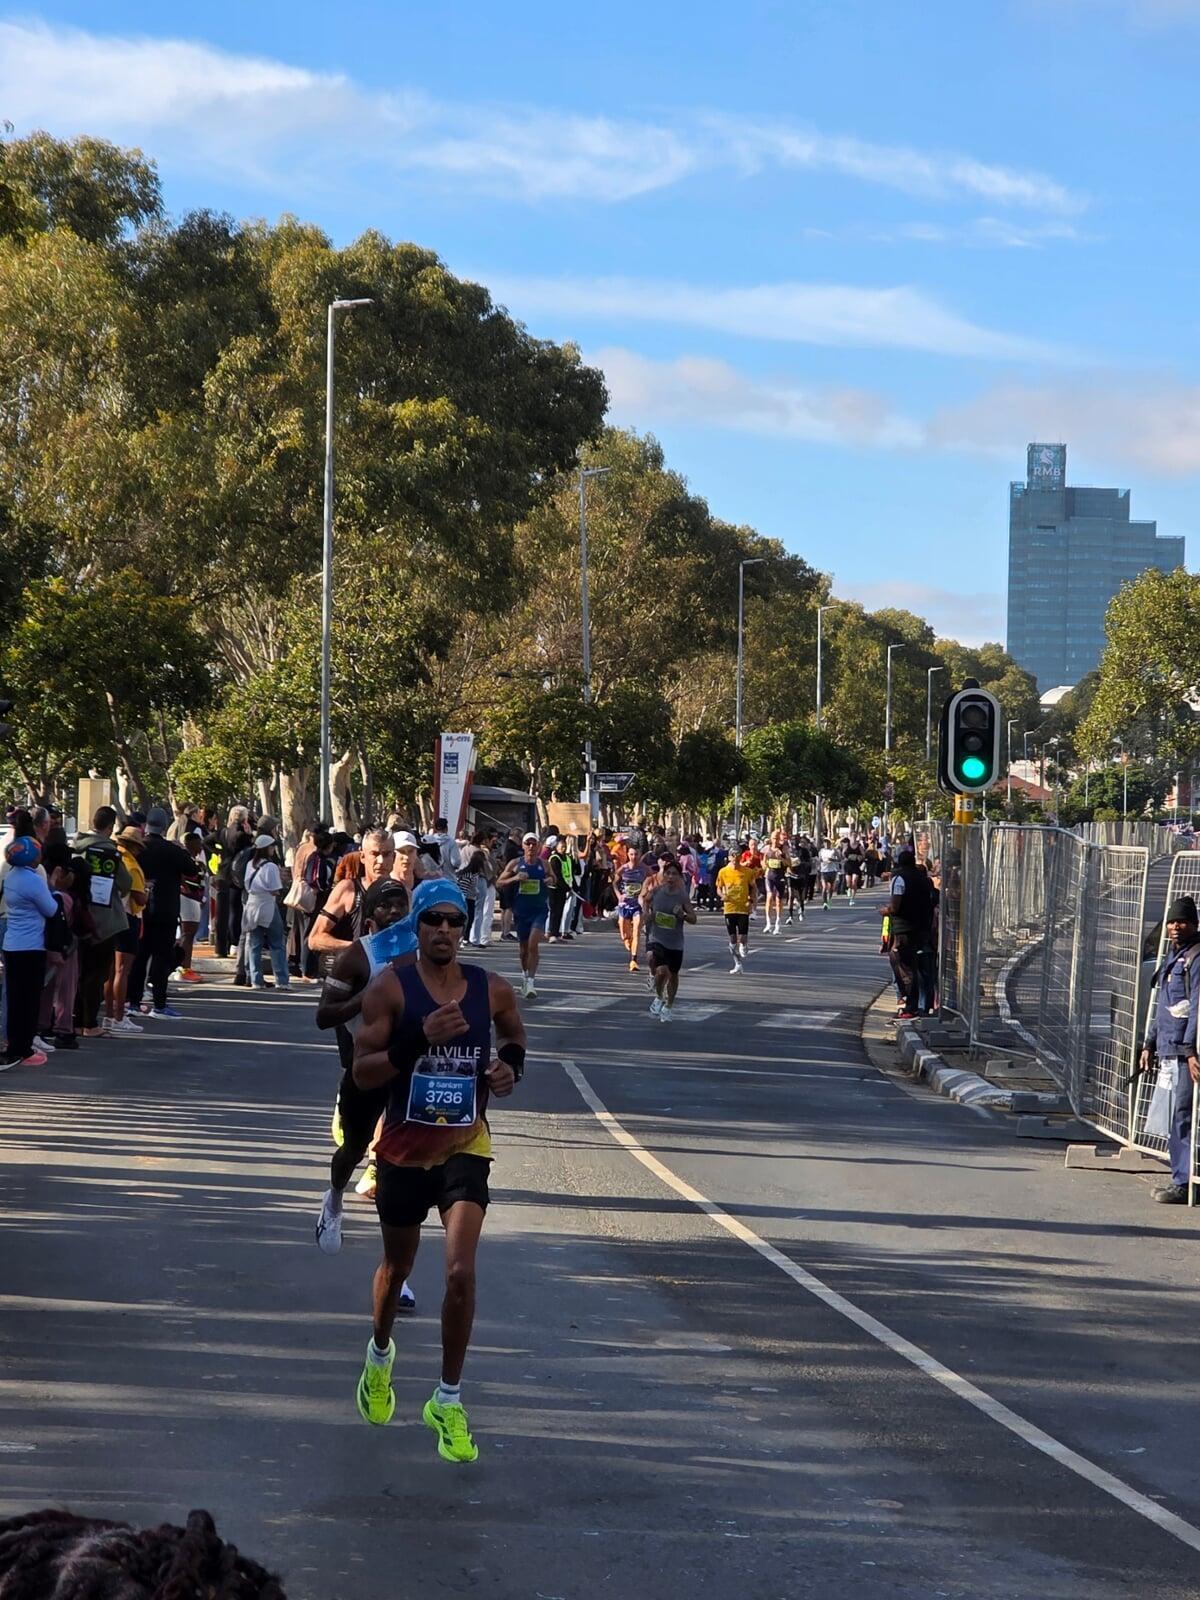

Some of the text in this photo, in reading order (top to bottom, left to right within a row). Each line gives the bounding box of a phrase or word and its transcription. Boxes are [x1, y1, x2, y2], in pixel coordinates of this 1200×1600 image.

[1033, 466, 1061, 477] RMB
[435, 1080, 463, 1089] Sanlam
[425, 1089, 463, 1104] 3736
